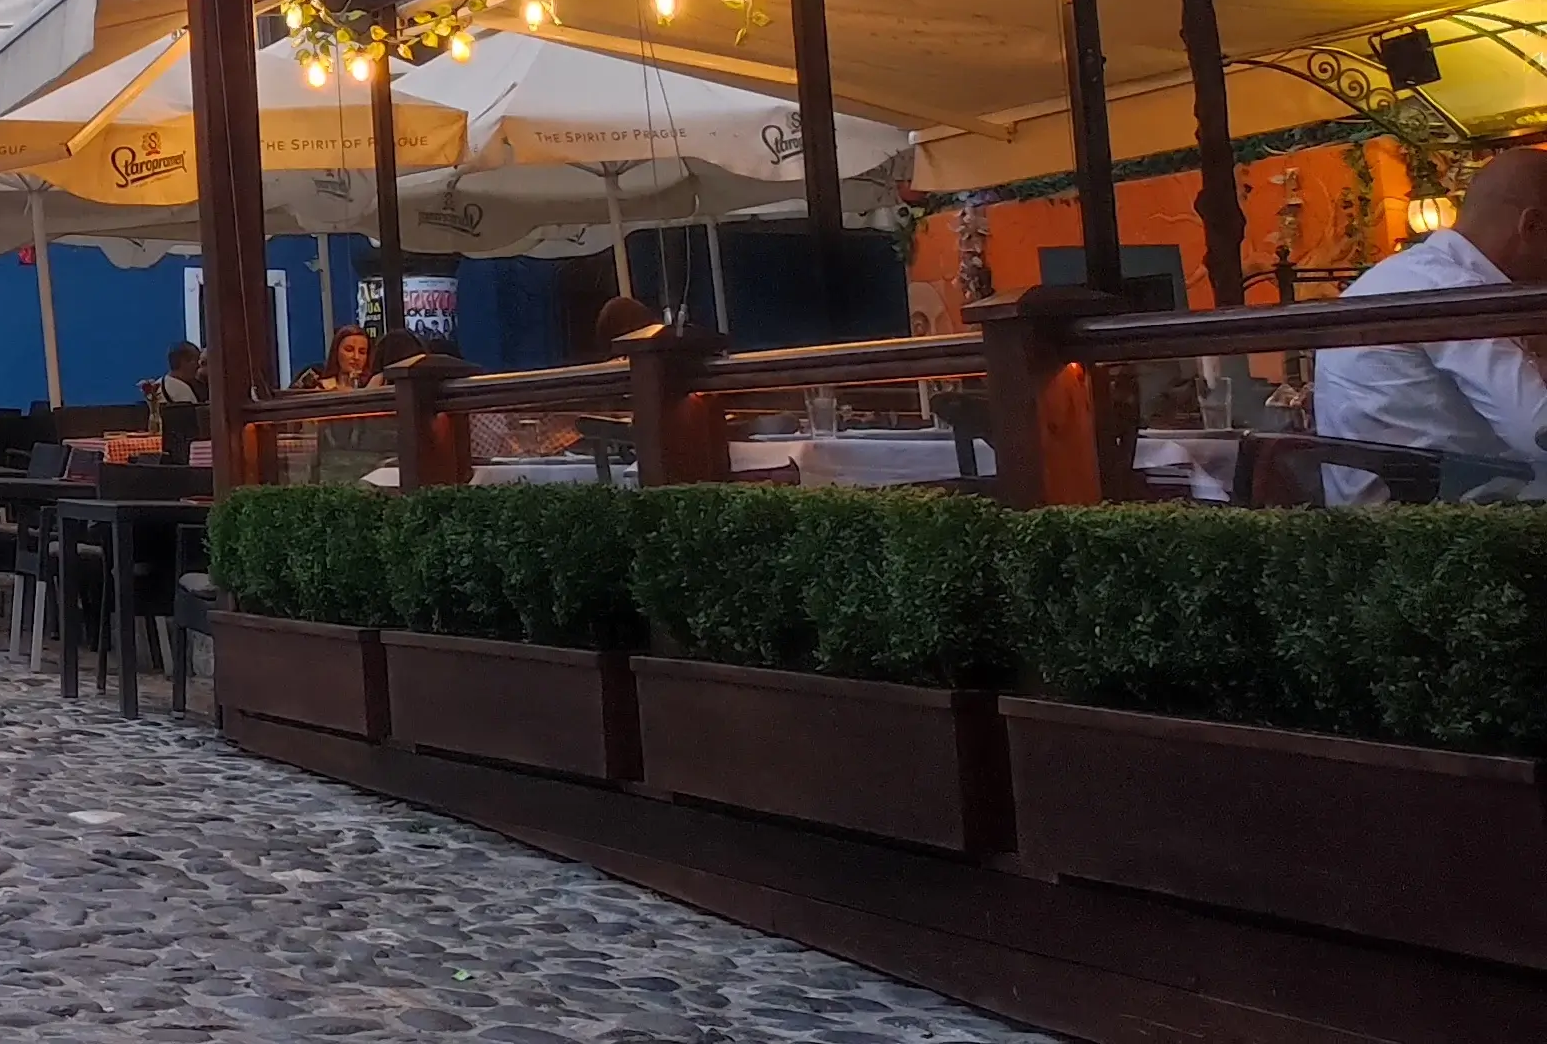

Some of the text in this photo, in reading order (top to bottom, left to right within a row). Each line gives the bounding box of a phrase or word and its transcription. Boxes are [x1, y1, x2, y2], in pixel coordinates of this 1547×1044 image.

[566, 131, 608, 143] SPIRIT
[633, 128, 688, 140] PRAGUE
[291, 139, 338, 151] SPIRIT
[368, 136, 429, 148] PGUE
